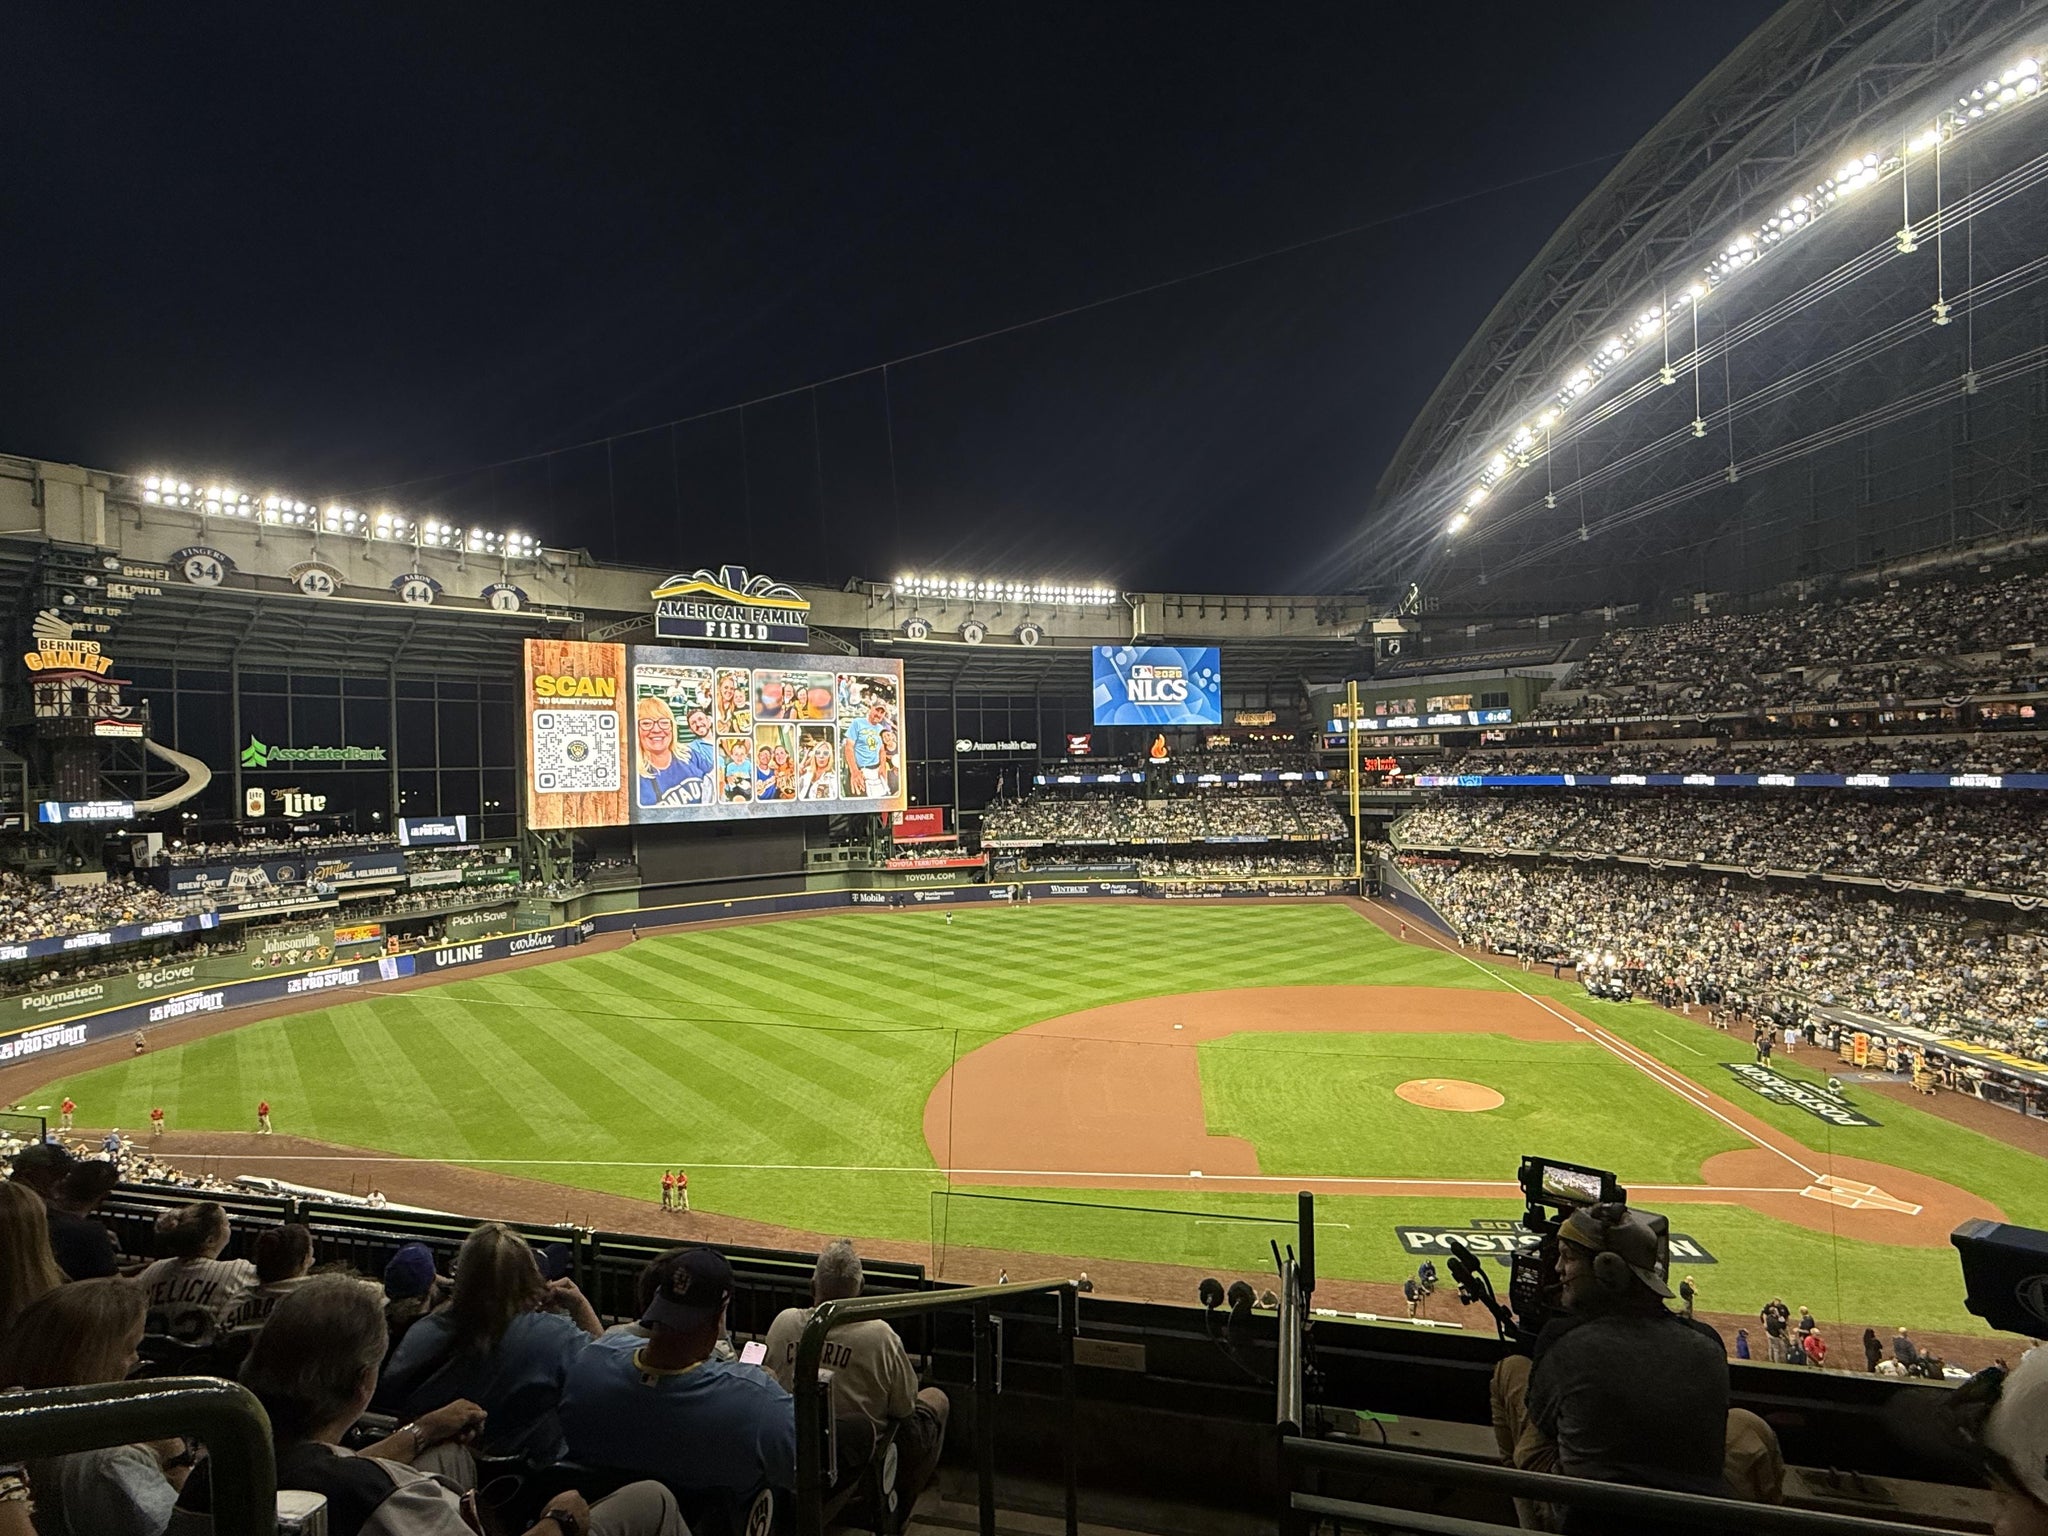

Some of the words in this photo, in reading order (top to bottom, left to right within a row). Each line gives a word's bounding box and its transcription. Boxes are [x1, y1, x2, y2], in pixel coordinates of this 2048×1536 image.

[181, 548, 226, 561] FINGERS
[122, 566, 170, 581] GONE!
[190, 561, 219, 580] 34
[303, 575, 330, 592] 42
[404, 574, 431, 584] AARON
[406, 586, 430, 603] 44
[493, 583, 516, 592] SELIG
[502, 597, 511, 610] 1
[83, 606, 104, 616] GET
[106, 608, 122, 617] UP
[657, 600, 746, 622] AMERICAN
[752, 608, 809, 626] FAMILY
[94, 624, 111, 633] UP
[705, 622, 769, 640] FIELD
[911, 627, 924, 638] 19
[969, 629, 977, 639] 4
[39, 639, 100, 654] BERNIE'S
[24, 650, 114, 675] CHALET
[535, 675, 616, 697] SCAN
[1128, 679, 1188, 701] NLCS
[267, 745, 387, 760] AssociatedBank
[973, 741, 996, 751] Aurora
[997, 741, 1019, 750] Health
[1020, 741, 1037, 750] Care
[283, 793, 327, 818] Lite
[905, 813, 935, 821] 4RUNNER
[314, 860, 354, 882] Miller
[889, 860, 913, 868] TOYOTA
[196, 873, 208, 882] GO
[356, 866, 398, 878] MILWAUKEE
[466, 870, 487, 878] POWER
[487, 868, 505, 876] ALLEY
[905, 873, 956, 882] TOYOTA.COM
[177, 881, 201, 890] BREW
[1050, 885, 1090, 894] WINTRUST
[860, 893, 885, 902] Mobile
[238, 902, 257, 910] GREAT
[452, 914, 475, 927] Pick
[483, 911, 508, 922] Save
[262, 933, 321, 954] Johnsonville
[510, 932, 556, 952] carbliss
[435, 944, 484, 966] ULINE
[153, 966, 196, 983] clover
[302, 976, 324, 991] PRO
[325, 968, 360, 987] SPIRIT
[22, 983, 104, 1010] Polymatech
[164, 1001, 184, 1018] PRO
[185, 992, 224, 1013] SPIRIT
[14, 1035, 42, 1057] PRO
[42, 1024, 88, 1048] SPIRIT
[1728, 1063, 1869, 1126] POSTSEASON
[786, 1342, 852, 1368] CRIO
